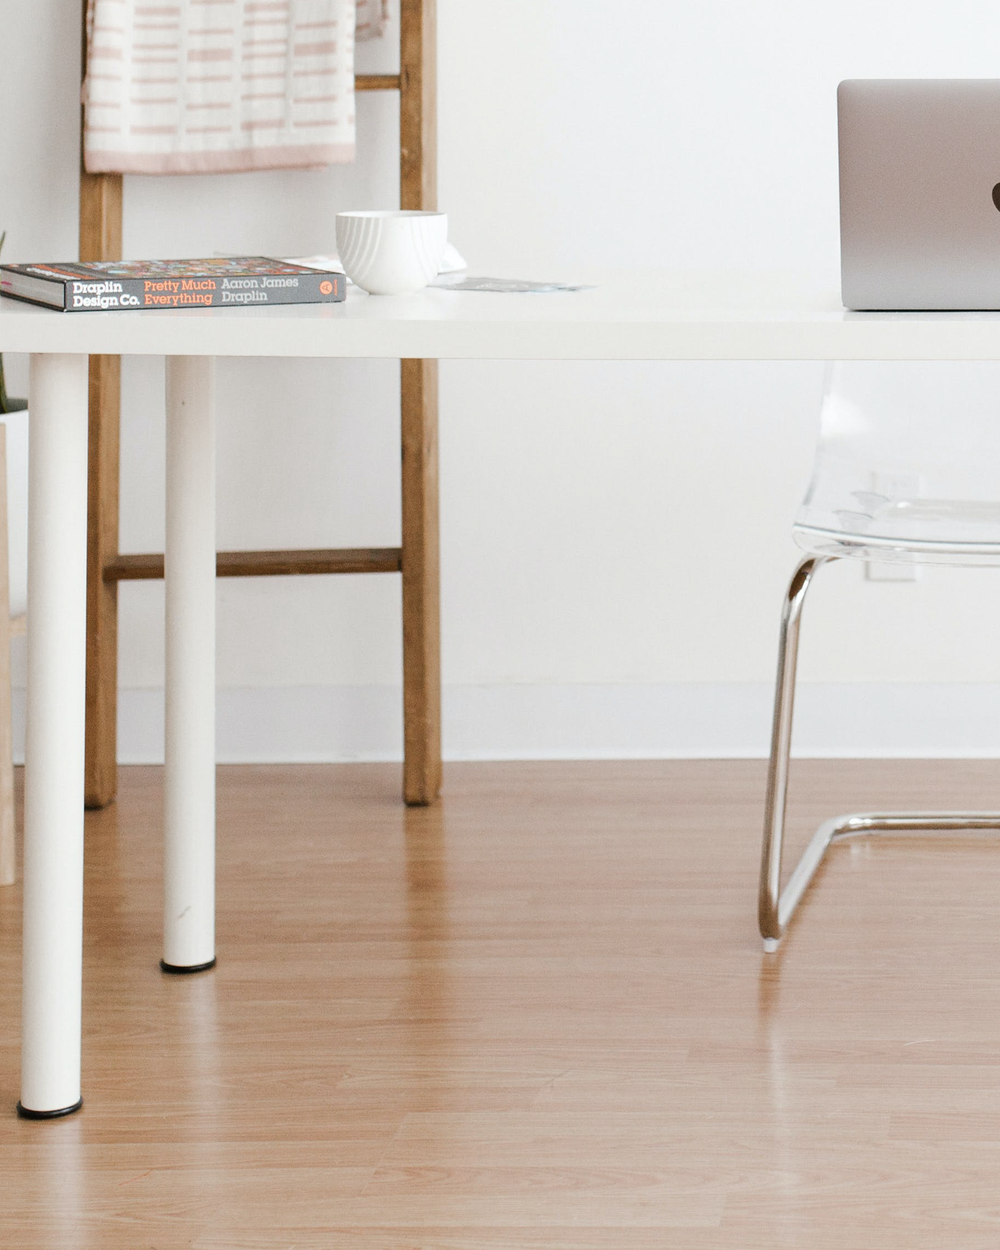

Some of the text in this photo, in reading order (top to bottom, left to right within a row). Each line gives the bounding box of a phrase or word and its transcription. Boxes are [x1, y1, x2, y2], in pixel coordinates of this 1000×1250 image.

[73, 281, 122, 295] Draplin
[144, 279, 216, 293] Pretty Much
[221, 277, 299, 290] Aaron James
[73, 294, 140, 308] Design Co.
[144, 293, 213, 306] Everything
[221, 291, 268, 304] Draplin
